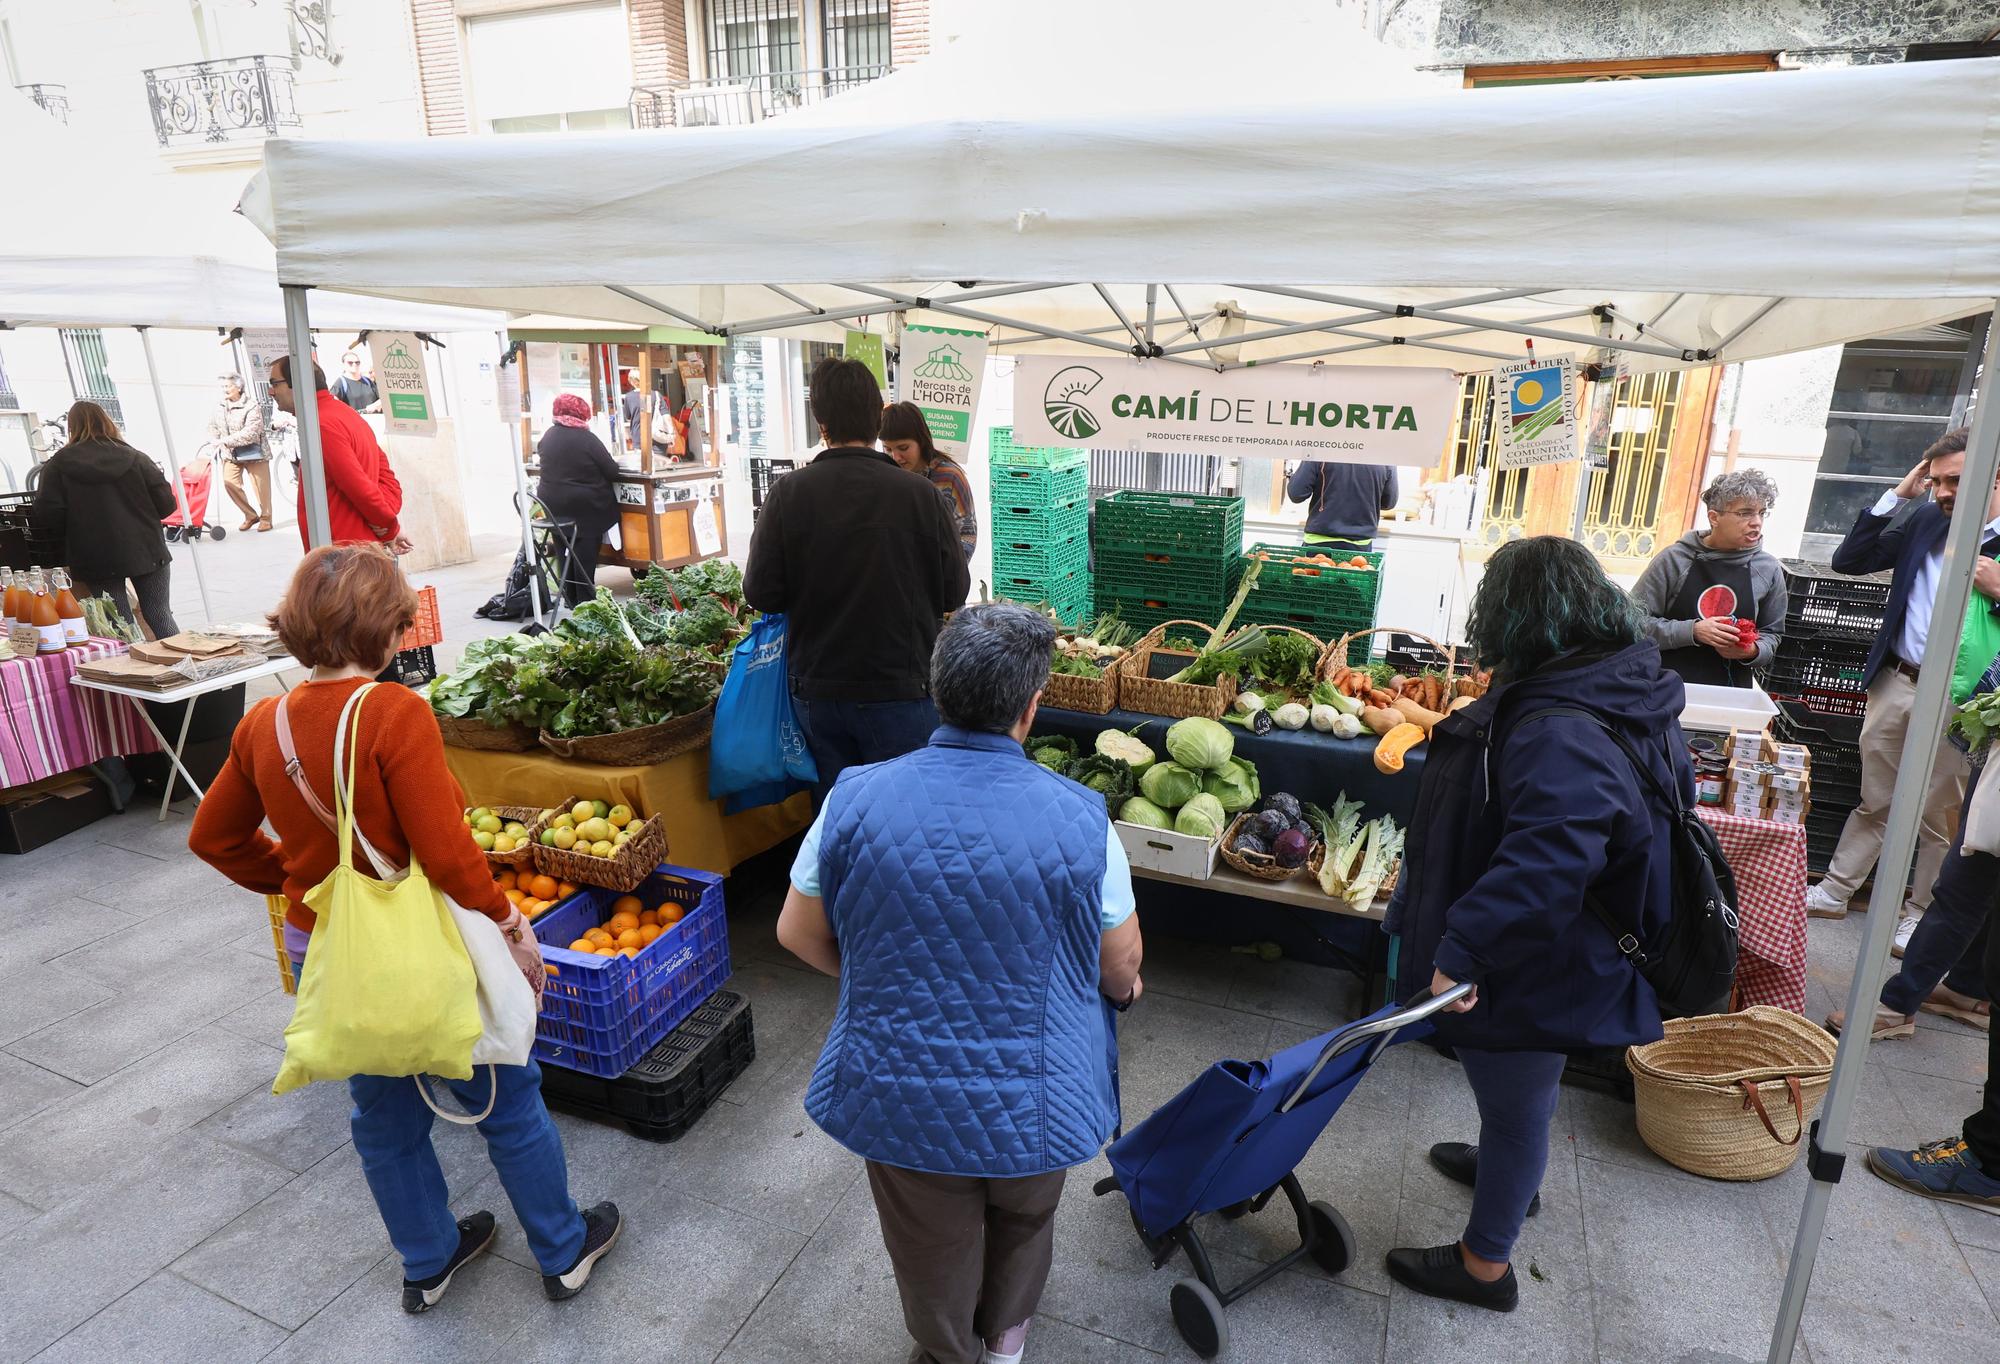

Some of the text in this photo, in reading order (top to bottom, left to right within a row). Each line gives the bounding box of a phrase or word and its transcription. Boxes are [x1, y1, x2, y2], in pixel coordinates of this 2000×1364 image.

[1500, 357, 1570, 374] AGRICULTURA
[384, 371, 420, 379] Mercats de
[386, 379, 423, 390] L'HORTA
[913, 379, 972, 394] Mercats de
[912, 389, 971, 407] L'HORTA
[926, 412, 954, 421] SUSANA
[1111, 389, 1418, 432] CAMÍ DE L'HORTA
[927, 421, 958, 430] ERRANDO
[1146, 432, 1191, 441] PRODUCTE
[1193, 434, 1220, 442] FRESC
[1222, 435, 1233, 443] DE
[1235, 436, 1289, 446] TEMPORADA
[1295, 440, 1365, 450] AGROECOLÒGIC
[1506, 444, 1571, 458] COMUNITAT
[1505, 452, 1574, 466] VALENCIANA
